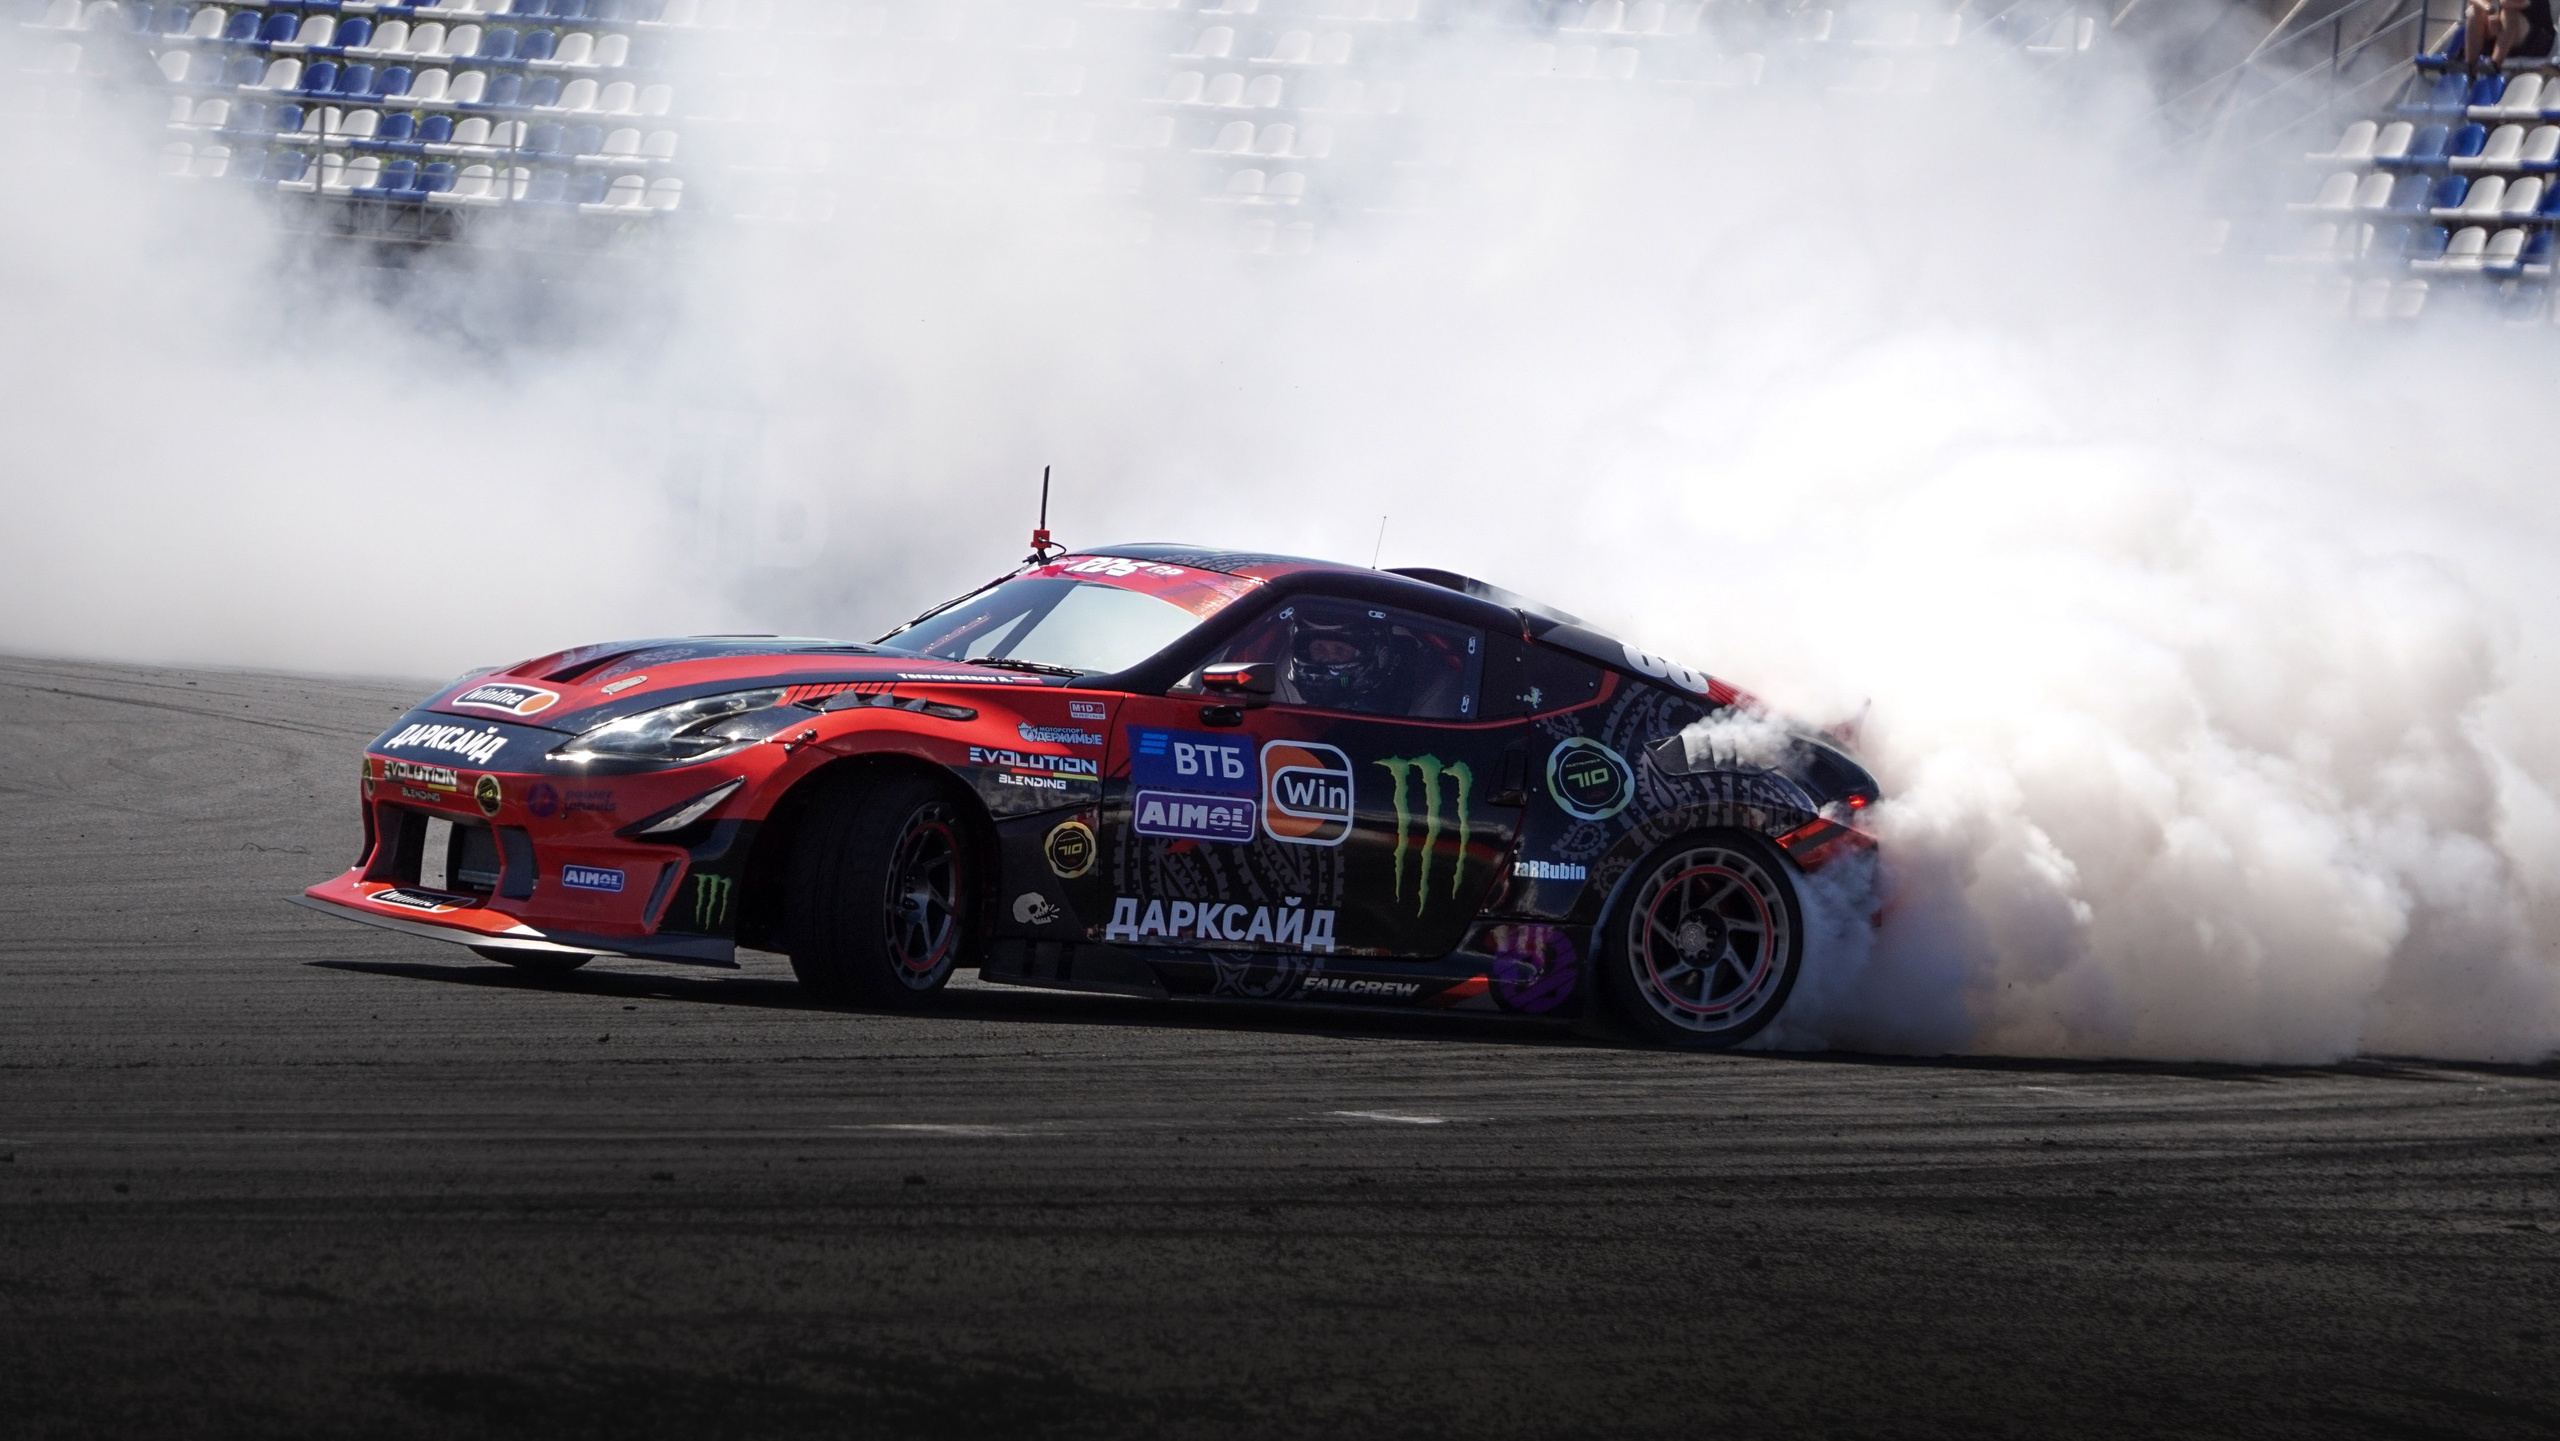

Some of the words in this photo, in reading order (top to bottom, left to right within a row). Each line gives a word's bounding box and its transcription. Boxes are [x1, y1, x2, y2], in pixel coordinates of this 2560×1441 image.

[1063, 557, 1157, 577] RDS
[383, 723, 508, 764] ДАРКСАЙД
[969, 746, 1097, 774] EVOLUTION
[1174, 742, 1245, 779] ВТБ
[384, 760, 458, 785] EVOLUTION
[998, 773, 1066, 790] BLENDING
[401, 787, 441, 802] BLENDING
[1283, 776, 1347, 810] Win
[566, 869, 622, 889] AIMOL
[1512, 860, 1586, 880] zaRRubin
[1105, 896, 1336, 953] ДАРКСАЙД
[1301, 977, 1420, 997] FAILCREW
